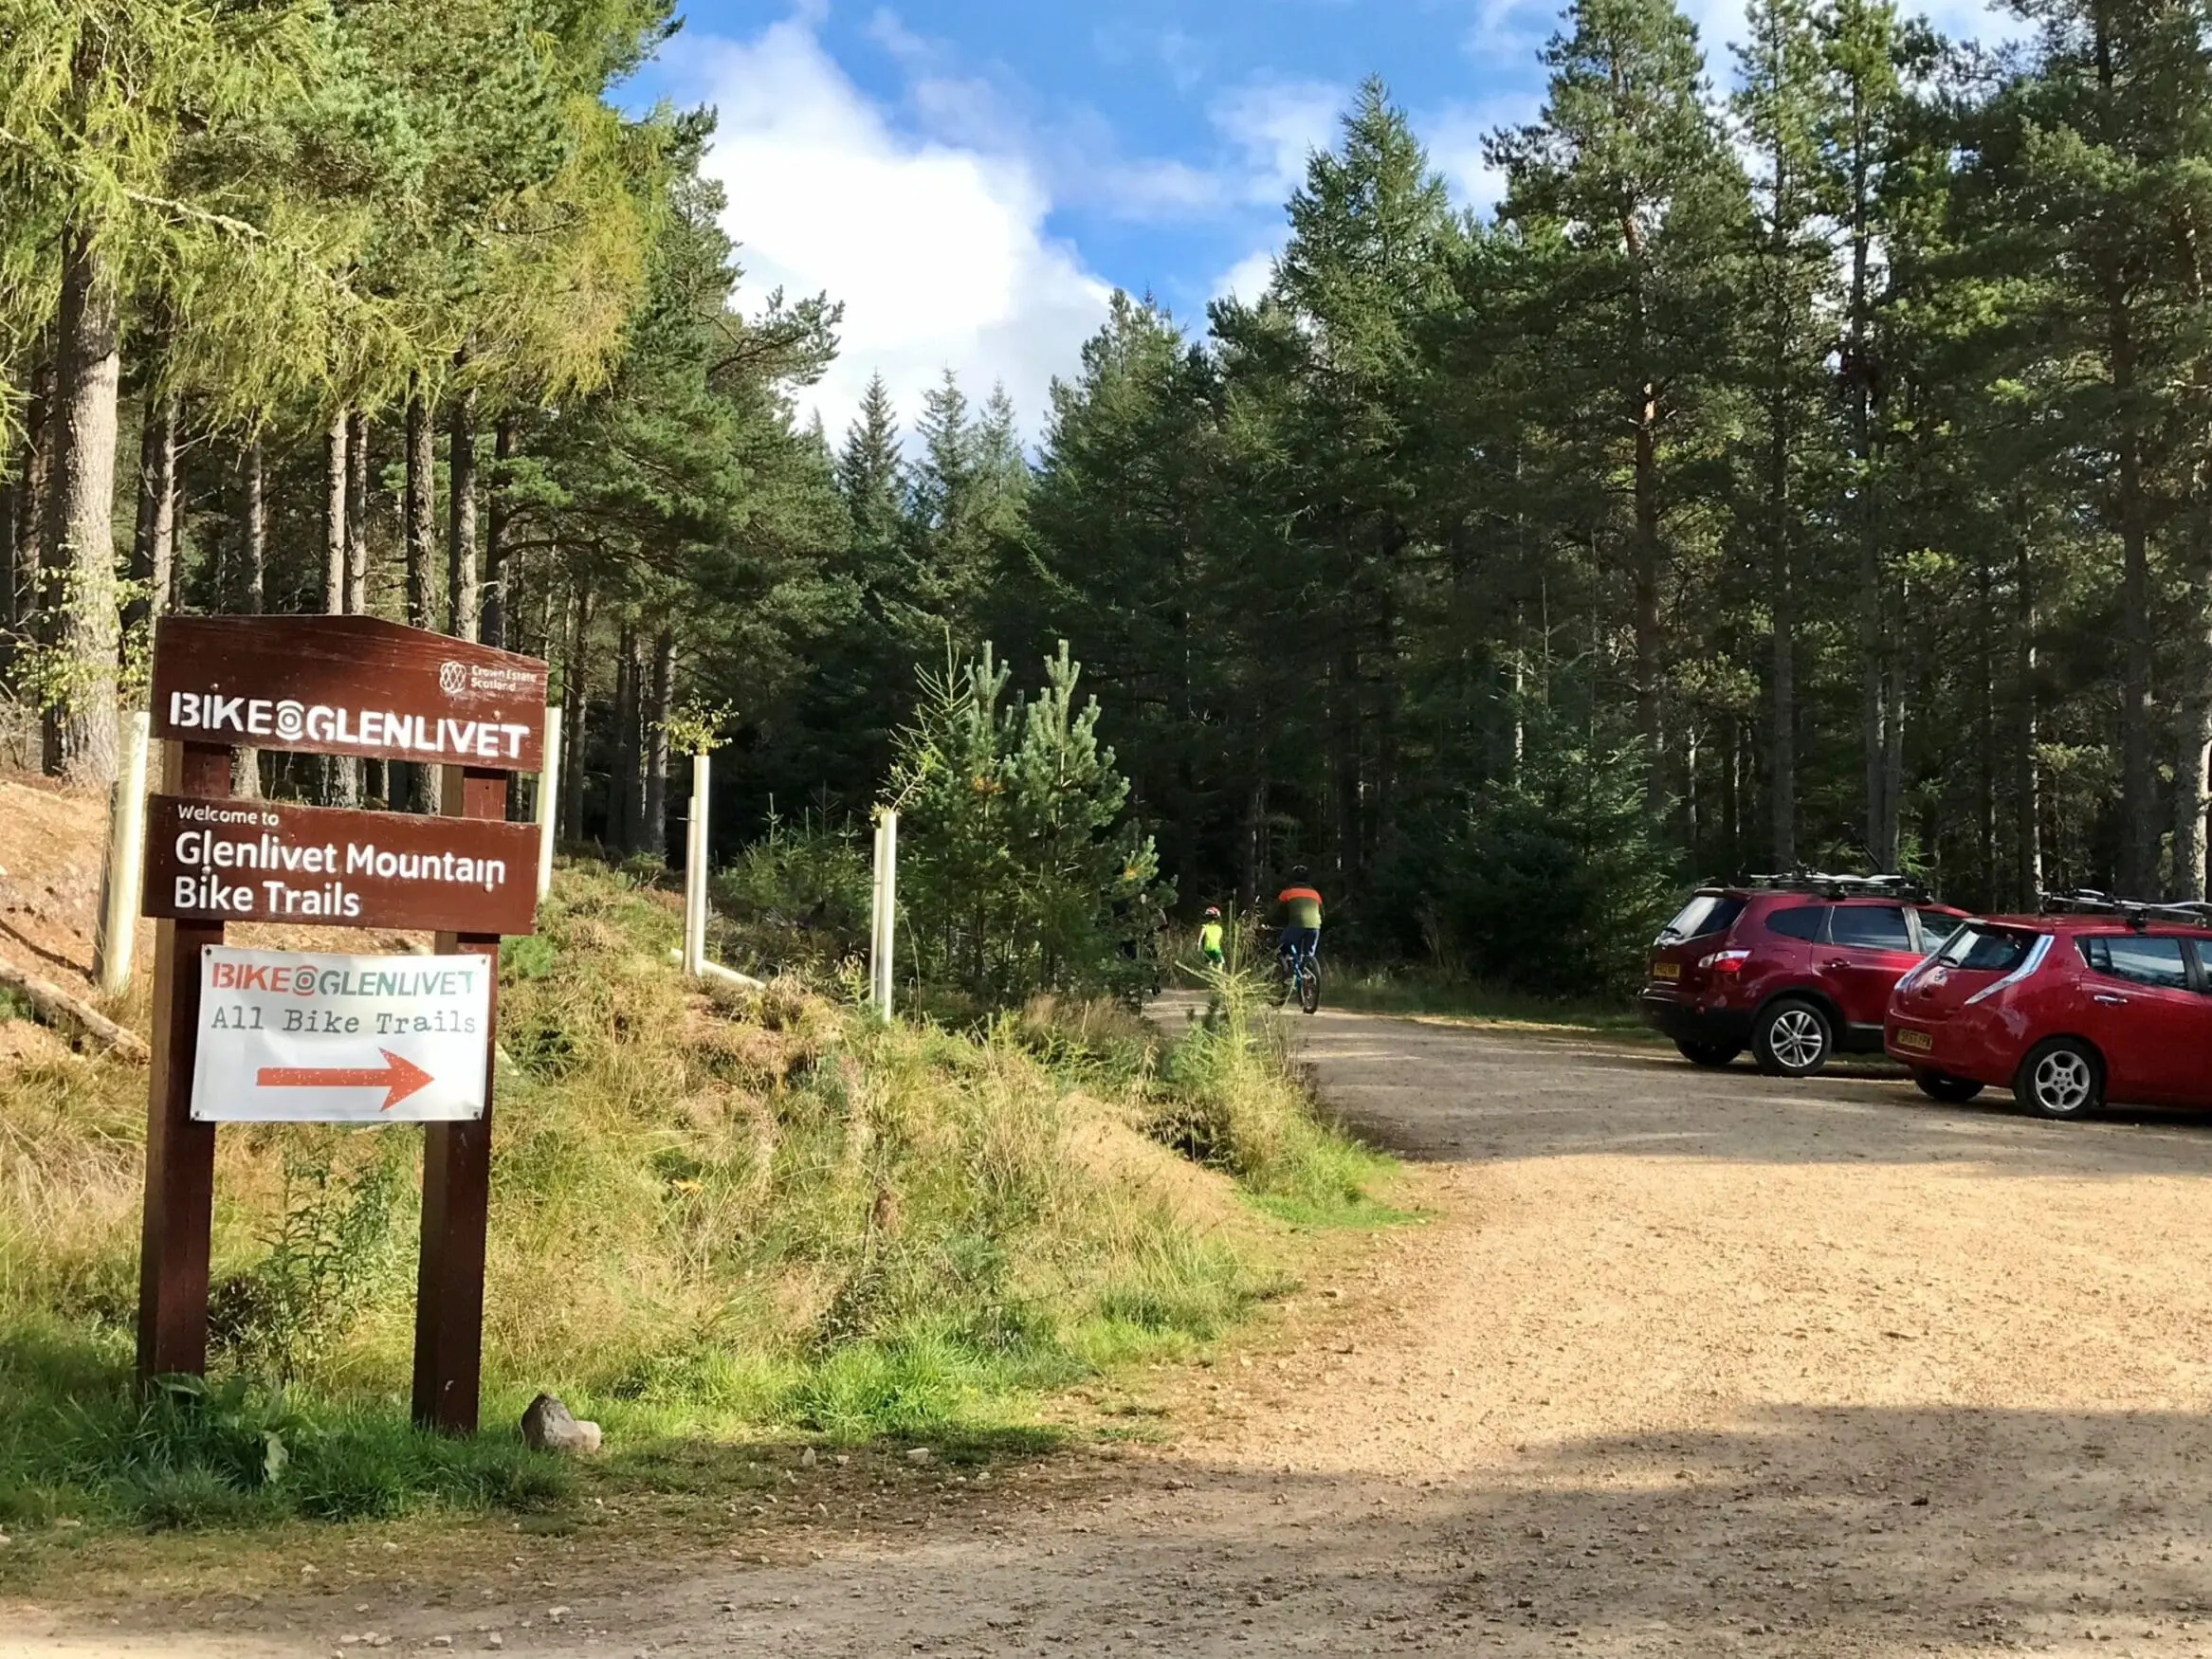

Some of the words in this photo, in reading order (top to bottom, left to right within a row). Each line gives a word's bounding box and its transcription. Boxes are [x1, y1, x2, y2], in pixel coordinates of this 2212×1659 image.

[471, 665, 504, 678] Crown
[470, 677, 517, 692] Scotland
[177, 805, 257, 825] Welcome
[261, 811, 280, 827] to
[174, 830, 338, 873] Glenlivet
[346, 844, 505, 884] Mountain
[174, 876, 253, 912] Bike
[263, 882, 360, 917] Trails
[210, 1006, 264, 1030] All
[282, 1009, 359, 1033] Bike
[375, 1011, 475, 1034] Trails
